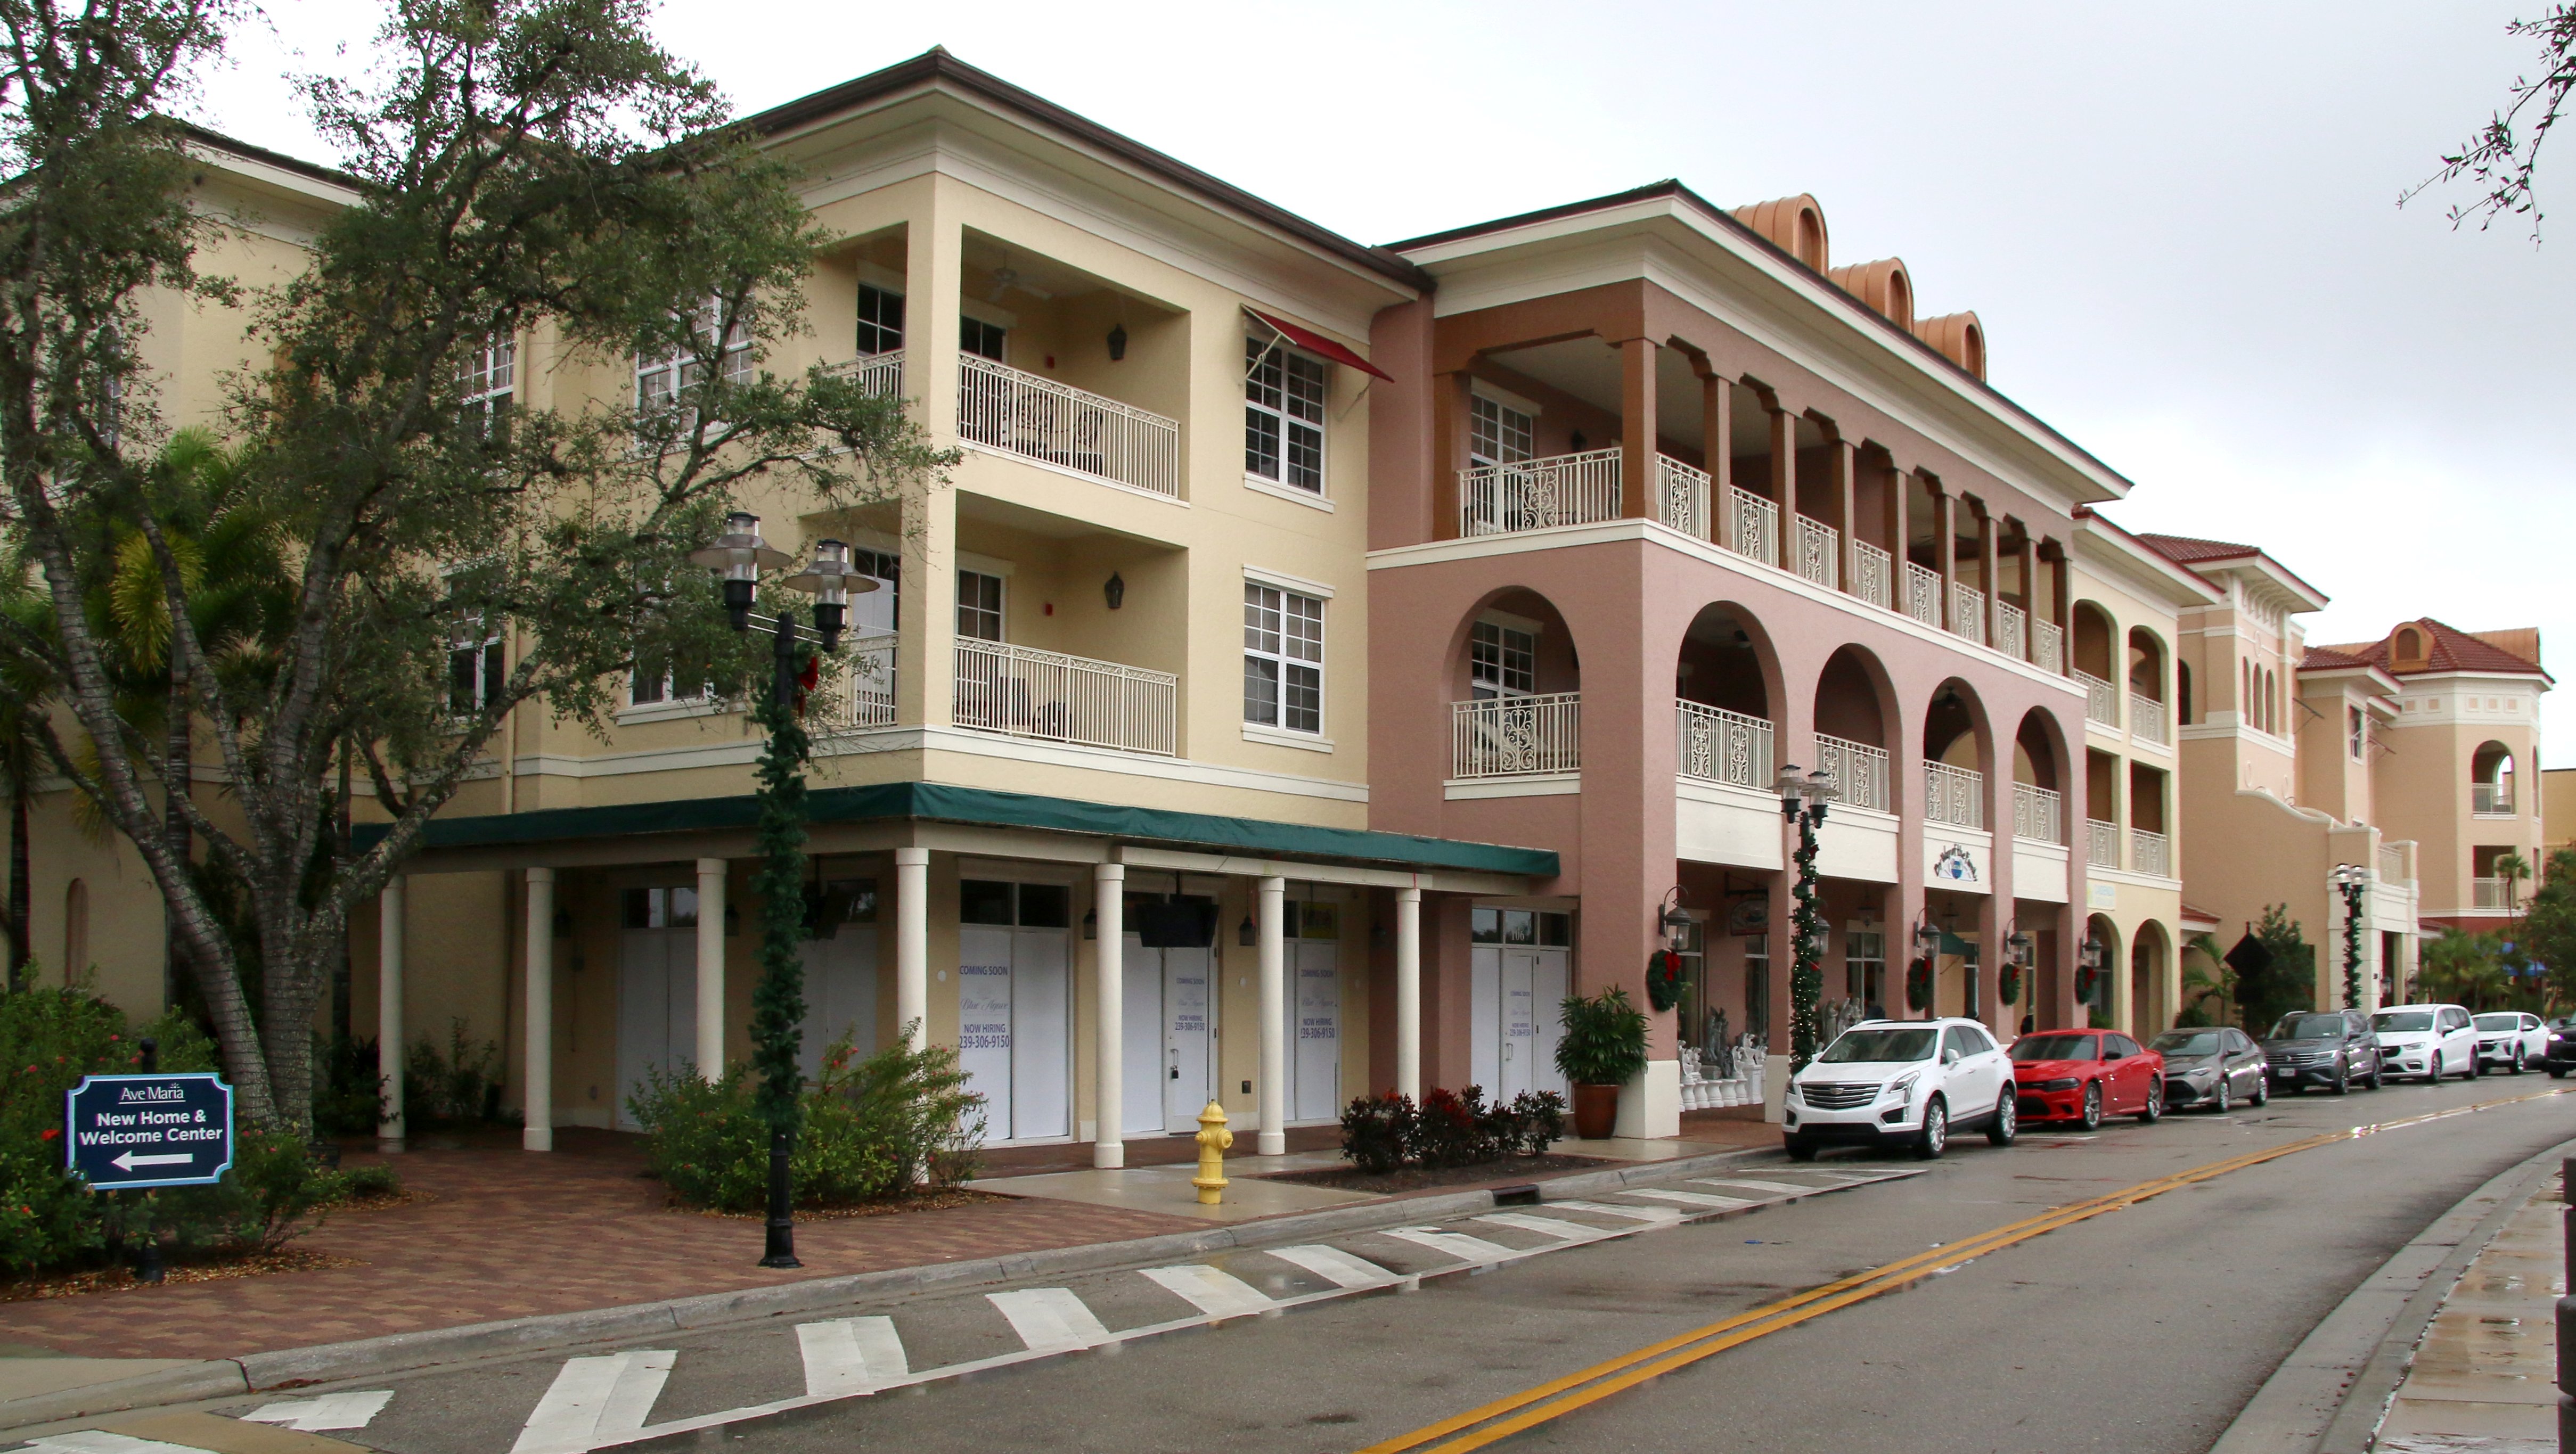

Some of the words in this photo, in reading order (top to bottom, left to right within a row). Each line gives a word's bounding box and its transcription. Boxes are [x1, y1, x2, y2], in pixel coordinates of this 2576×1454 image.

[960, 966, 987, 975] COMING
[989, 966, 1008, 975] SOON
[964, 1024, 980, 1033] NOW
[982, 1024, 1005, 1033] HIRING
[960, 1036, 1010, 1048] 239-306-9150
[121, 1087, 145, 1100] Ave
[147, 1086, 184, 1100] Maria
[97, 1113, 136, 1127] New
[141, 1111, 190, 1124] Home
[195, 1109, 207, 1122] &
[80, 1130, 162, 1145] Welcome
[166, 1127, 223, 1141] Center
